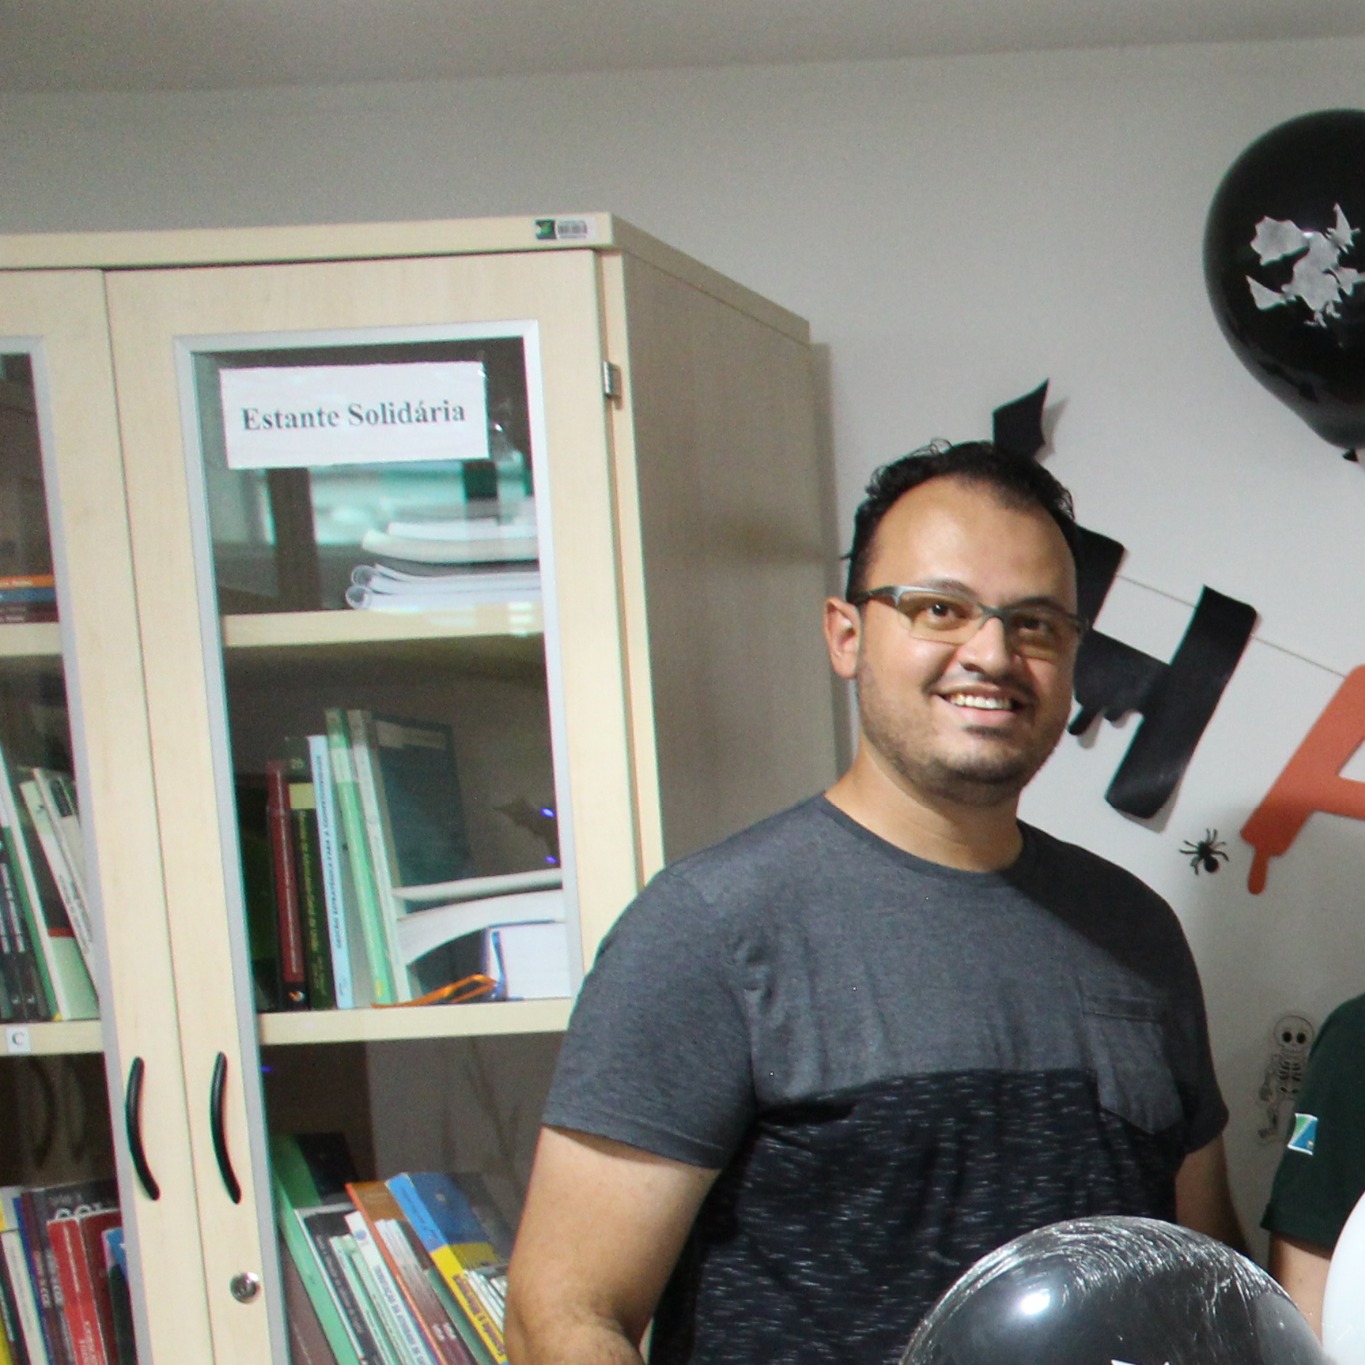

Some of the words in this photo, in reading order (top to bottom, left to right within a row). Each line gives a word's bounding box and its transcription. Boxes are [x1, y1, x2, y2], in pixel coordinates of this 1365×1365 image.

[241, 406, 340, 433] Estante
[348, 398, 466, 427] Solidária
[12, 1032, 25, 1046] C
